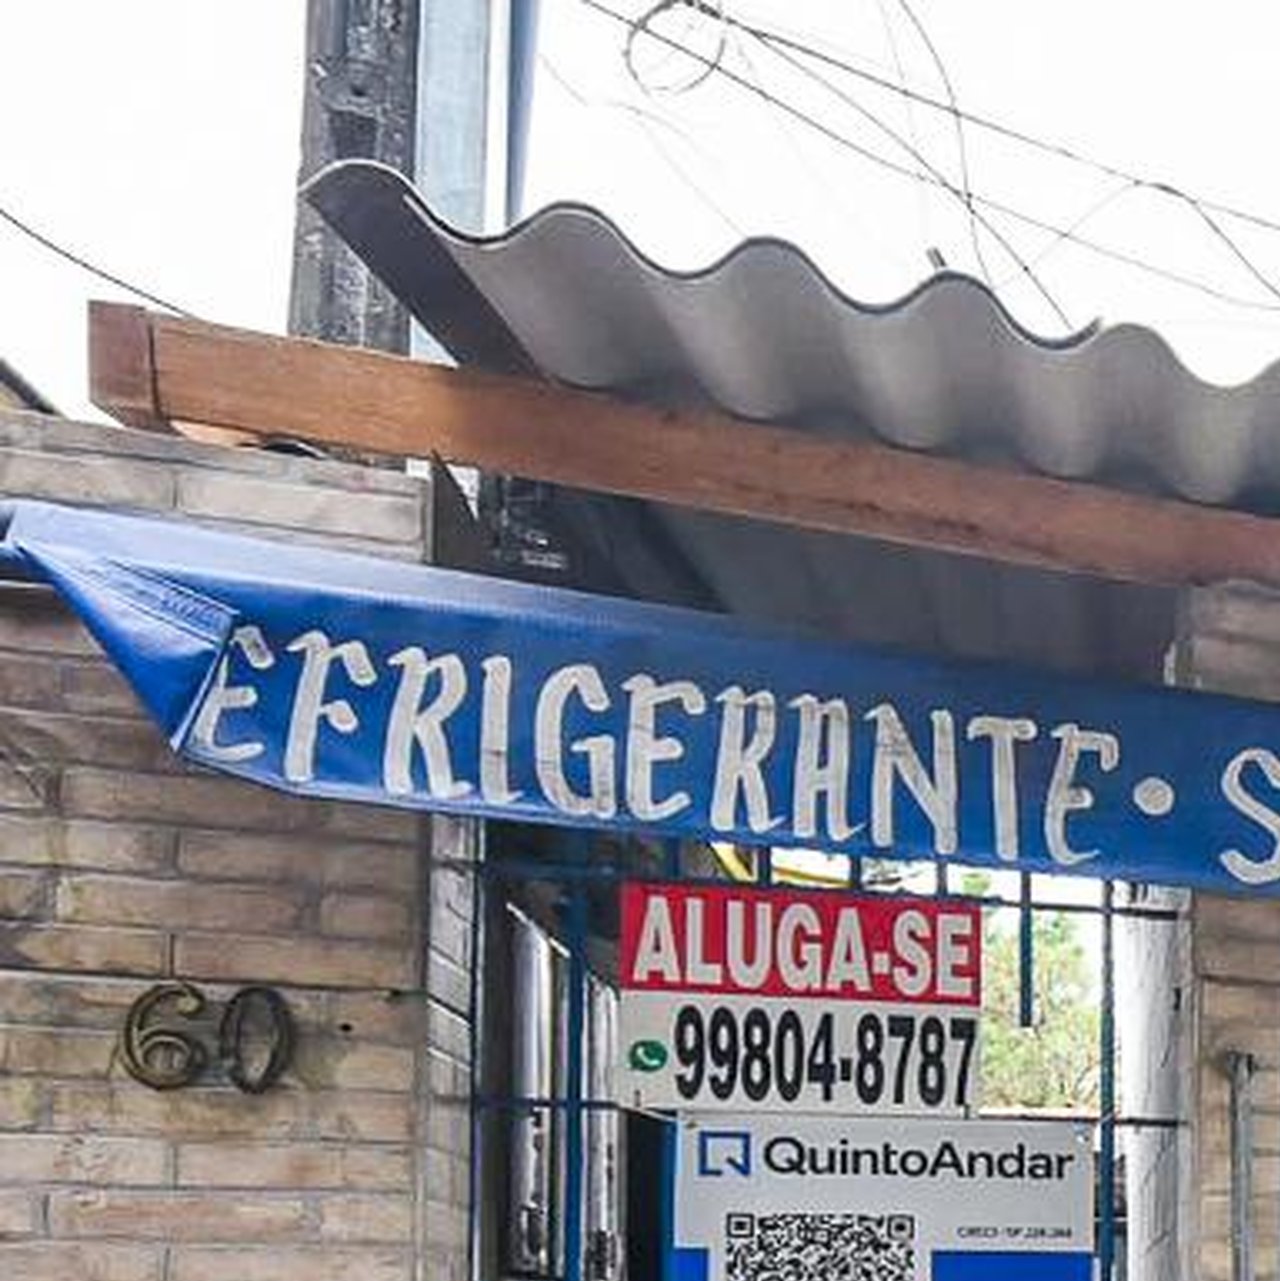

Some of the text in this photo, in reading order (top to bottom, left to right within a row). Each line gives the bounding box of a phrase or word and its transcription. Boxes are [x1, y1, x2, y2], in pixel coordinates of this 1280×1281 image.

[632, 896, 973, 998] ALUGA-SE
[124, 983, 296, 1093] 60
[674, 1005, 978, 1107] 99804-8787
[763, 1136, 1075, 1180] QuintoAndar
